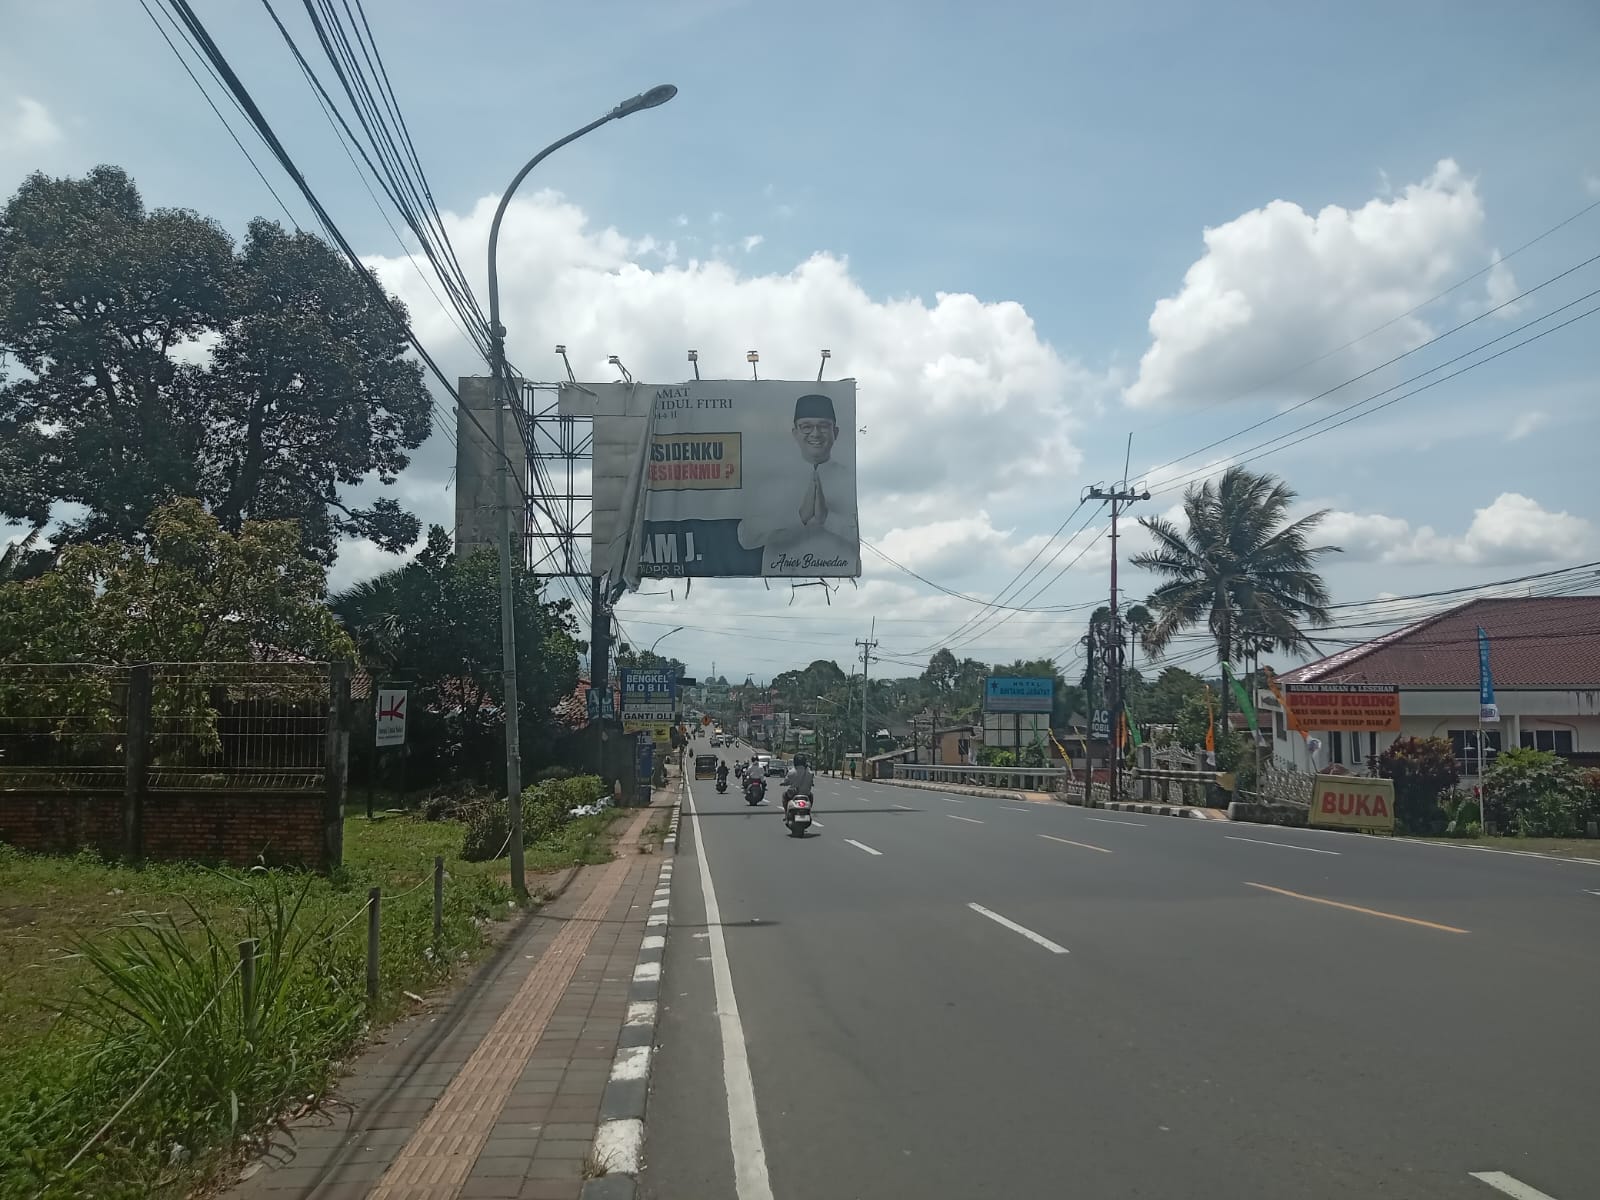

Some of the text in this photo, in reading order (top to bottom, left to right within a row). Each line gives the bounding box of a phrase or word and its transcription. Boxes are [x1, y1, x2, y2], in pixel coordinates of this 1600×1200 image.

[661, 400, 693, 410] IDUL
[697, 399, 733, 409] FITRI
[684, 532, 703, 562] J.
[771, 553, 849, 572] Anies Baswedan
[674, 564, 685, 575] RI
[626, 674, 669, 683] BENGKEL
[626, 684, 670, 692] MOBIL
[1092, 709, 1109, 723] AC
[1321, 791, 1389, 818] BUKA
